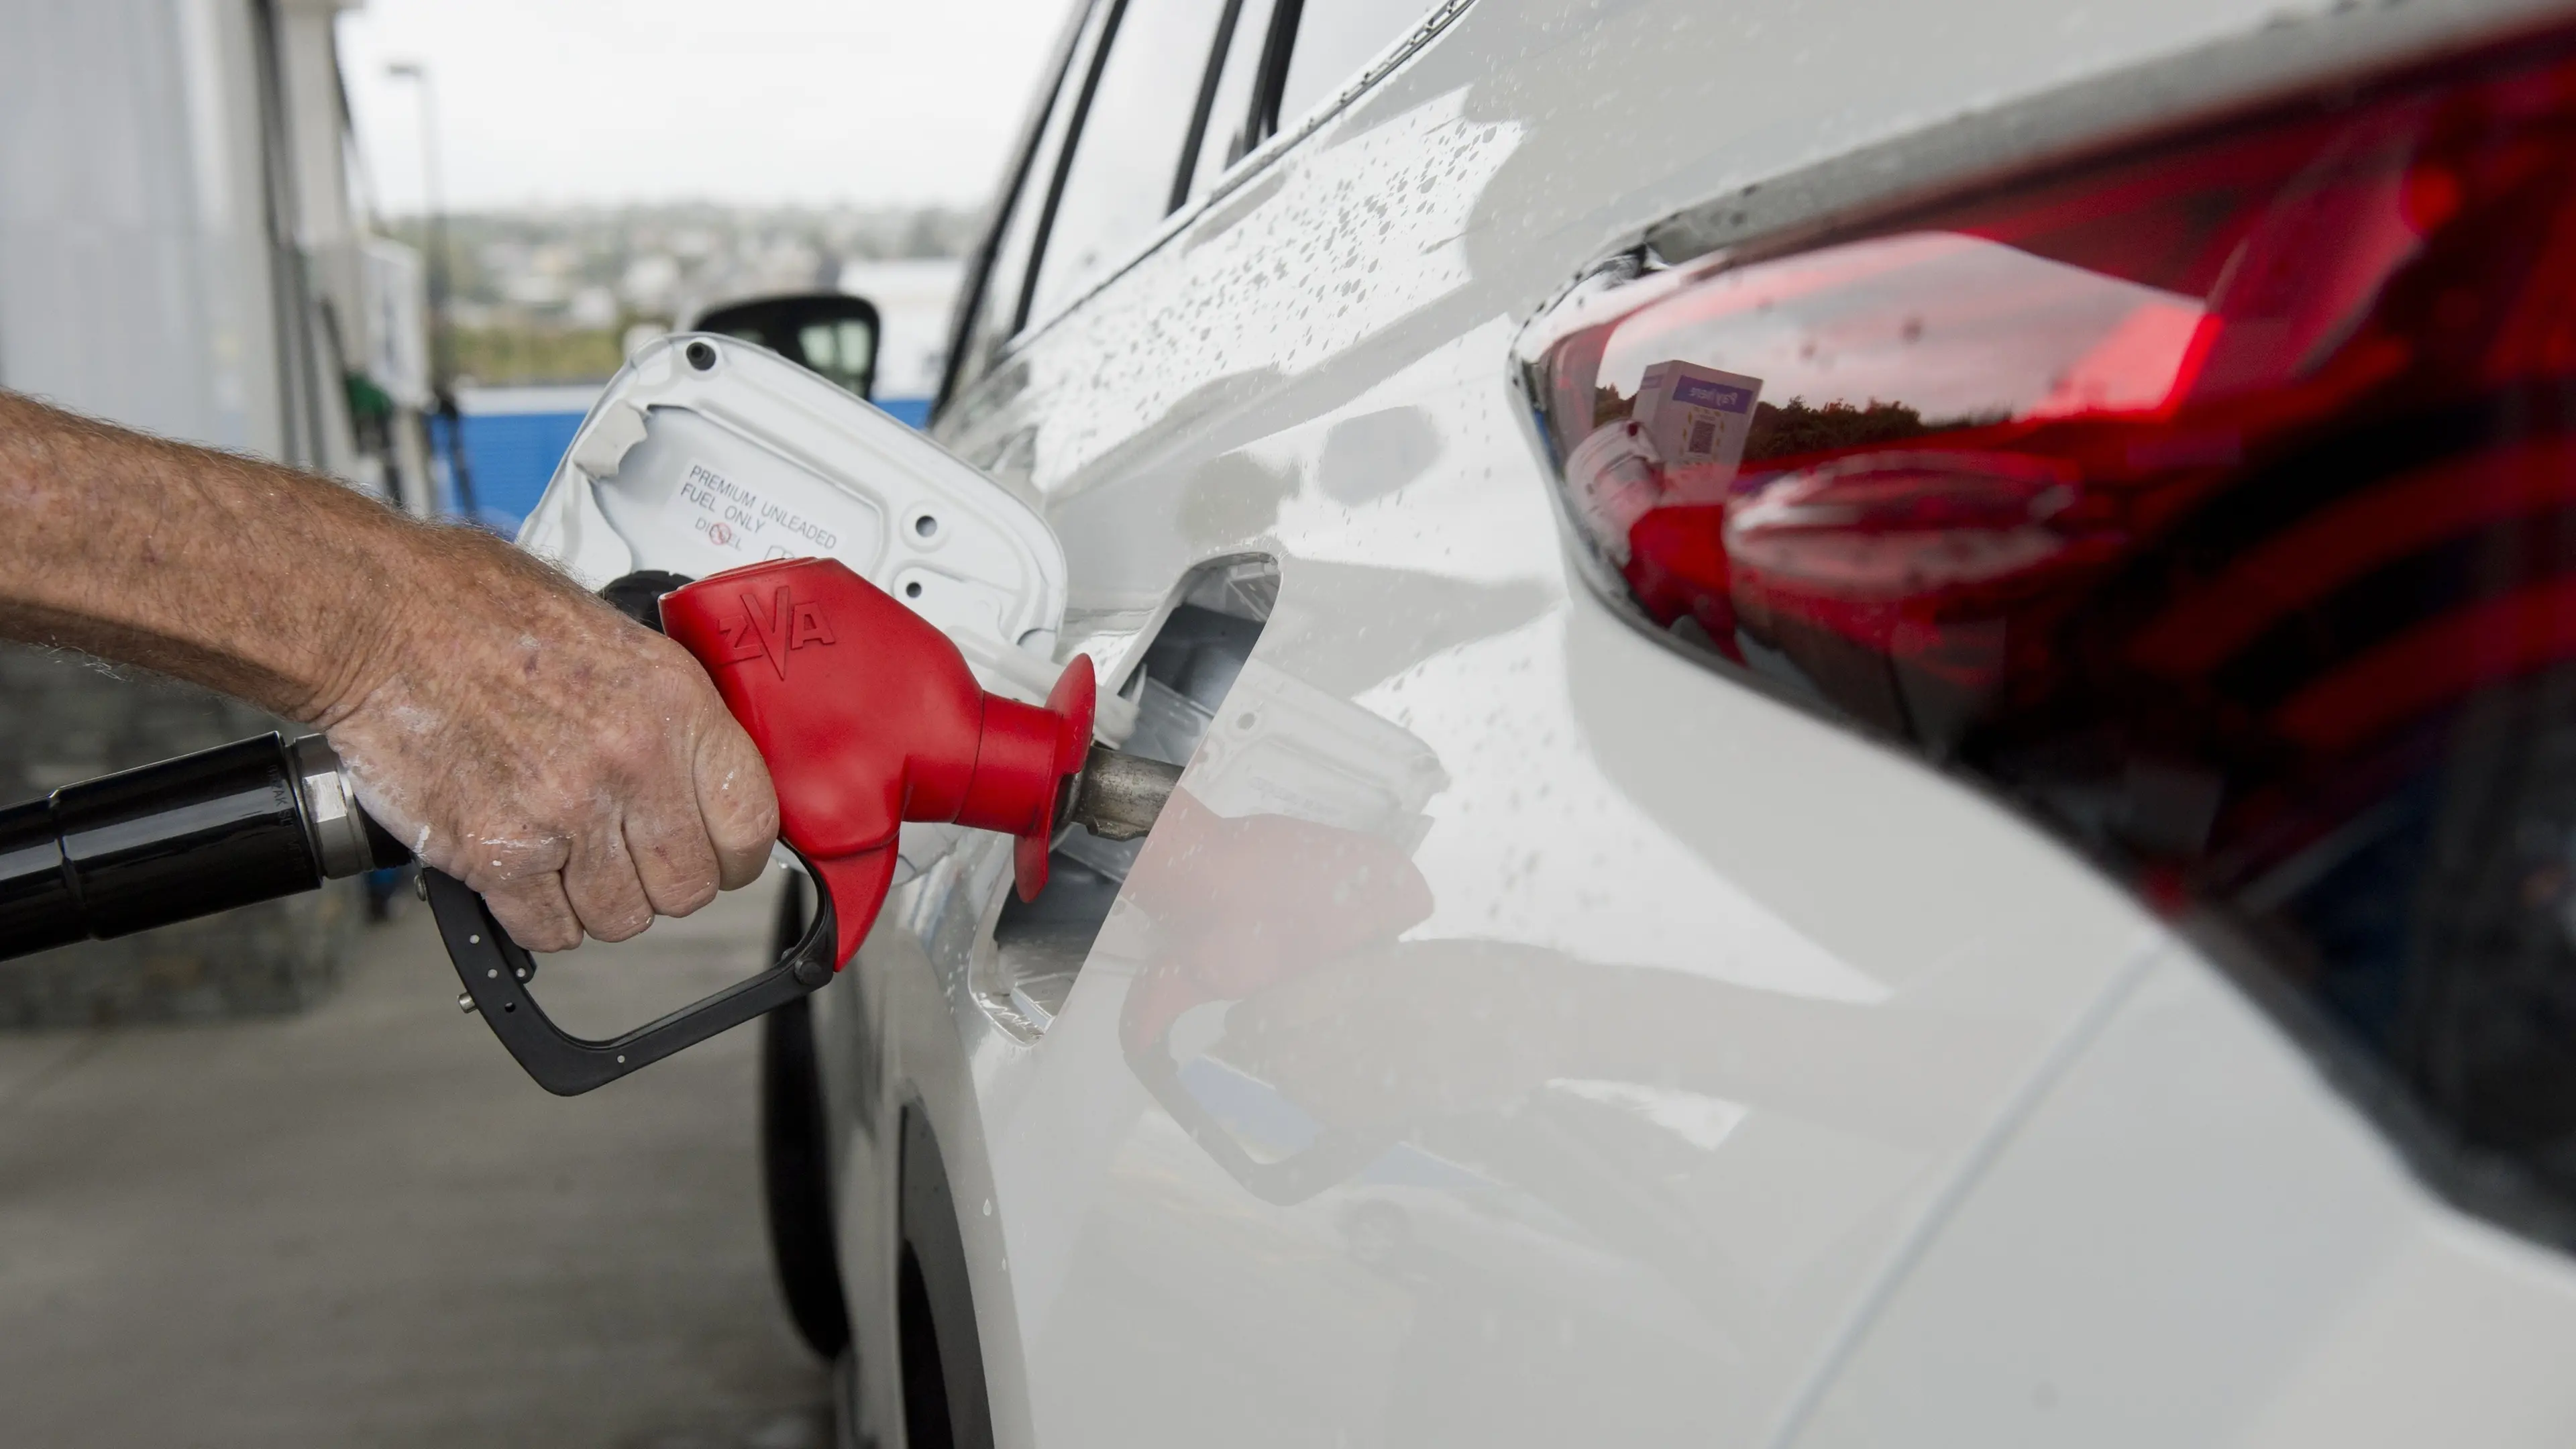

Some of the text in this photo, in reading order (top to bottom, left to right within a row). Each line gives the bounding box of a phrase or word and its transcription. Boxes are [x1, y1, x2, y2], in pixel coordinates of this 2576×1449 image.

[681, 482, 766, 534] FUEL ONLY
[689, 465, 837, 550] PREMIUM UNLEADED
[694, 517, 743, 552] DIEL
